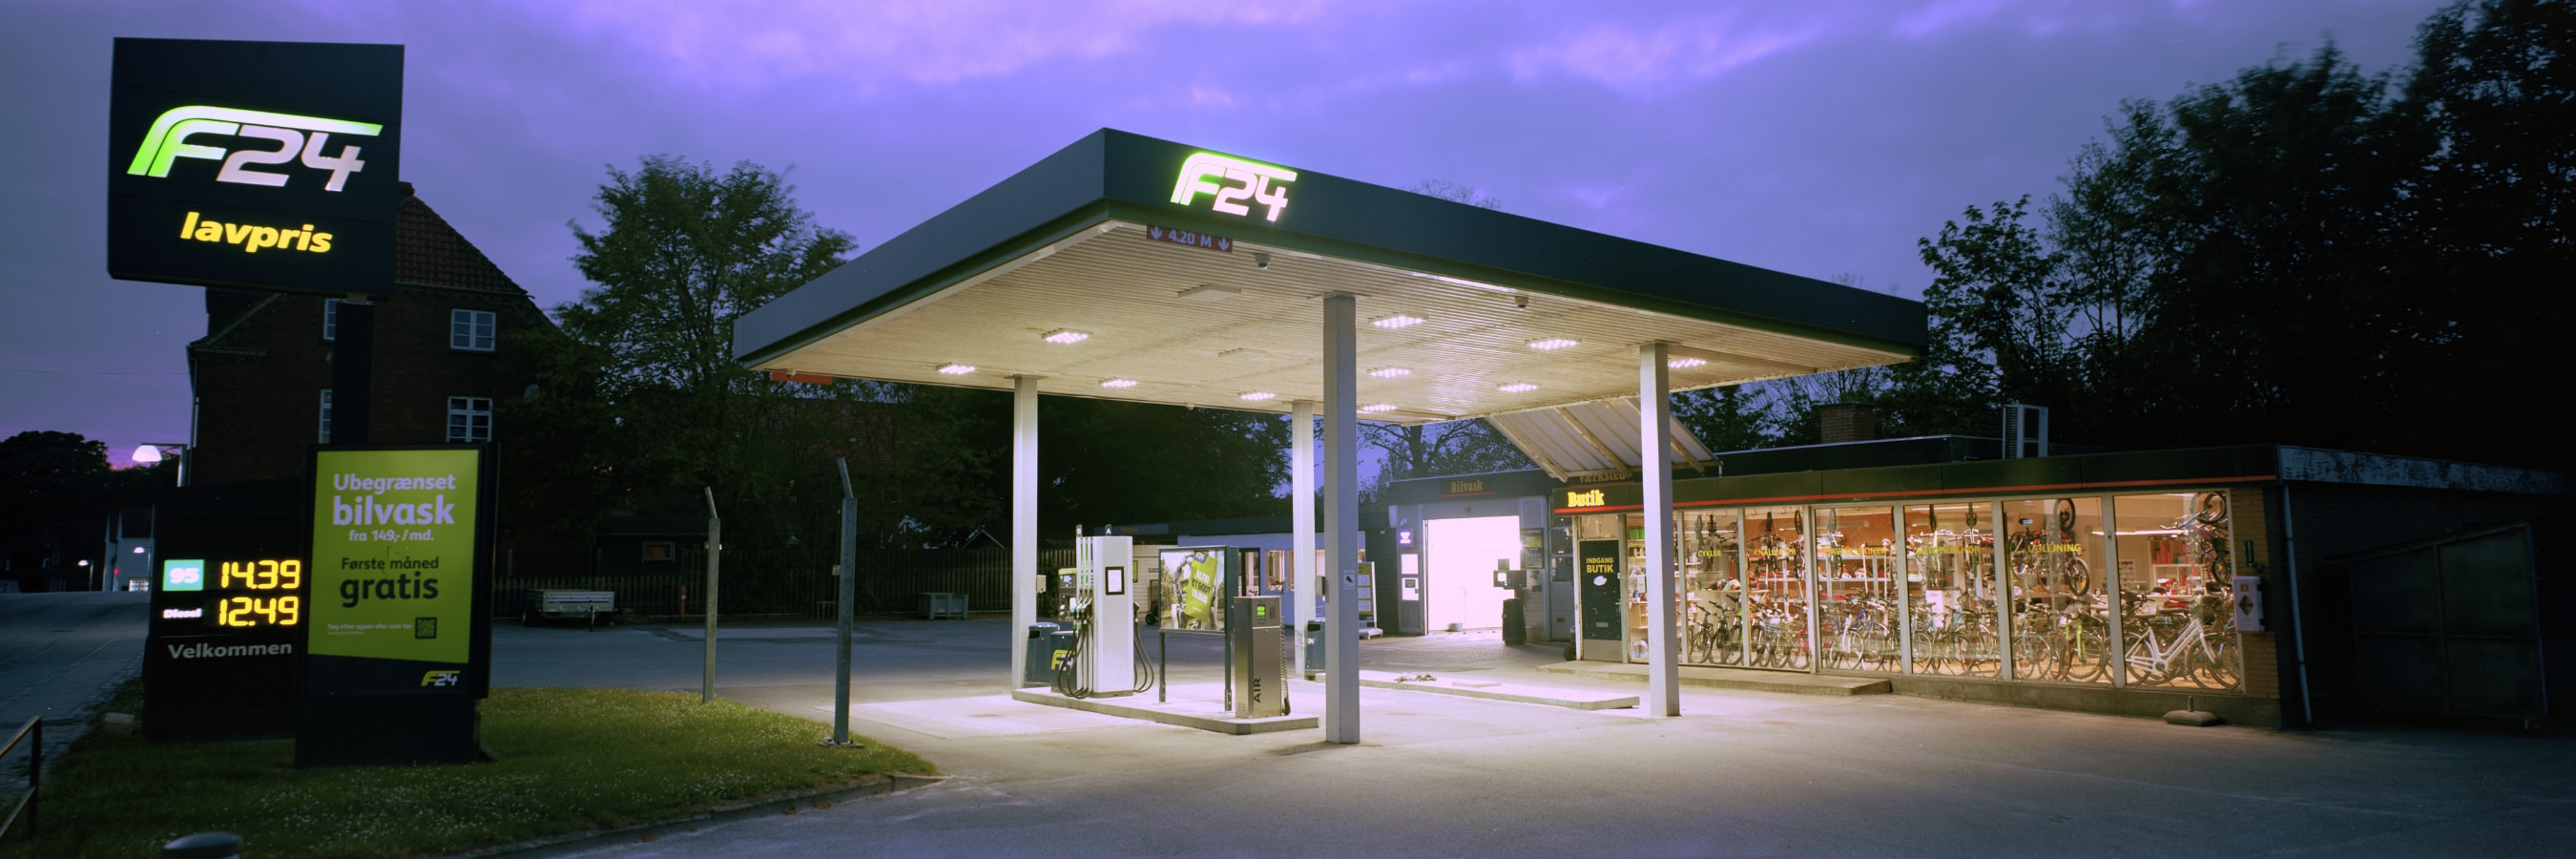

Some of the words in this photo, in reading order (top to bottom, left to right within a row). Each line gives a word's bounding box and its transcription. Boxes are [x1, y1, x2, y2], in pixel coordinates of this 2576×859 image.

[126, 105, 384, 192] F24
[1170, 152, 1298, 222] F24
[179, 211, 333, 254] lavpris
[1168, 229, 1195, 245] 4.20
[1200, 235, 1212, 248] M
[334, 473, 456, 494] Ubegrænset
[1450, 480, 1484, 493] Bilvask
[1568, 489, 1605, 508] Butik
[333, 494, 455, 526] bilvask
[348, 530, 367, 541] fra
[342, 557, 384, 571] Første
[390, 556, 439, 570] måned
[1586, 564, 1614, 574] BUTIK
[169, 567, 199, 584] 95
[220, 559, 301, 590] 14.39
[340, 571, 438, 609] gratis
[163, 608, 203, 619] Diesel
[218, 596, 300, 627] 12.49
[167, 643, 292, 659] Velkommen
[421, 669, 461, 686] F24
[1253, 678, 1261, 703] AIR
